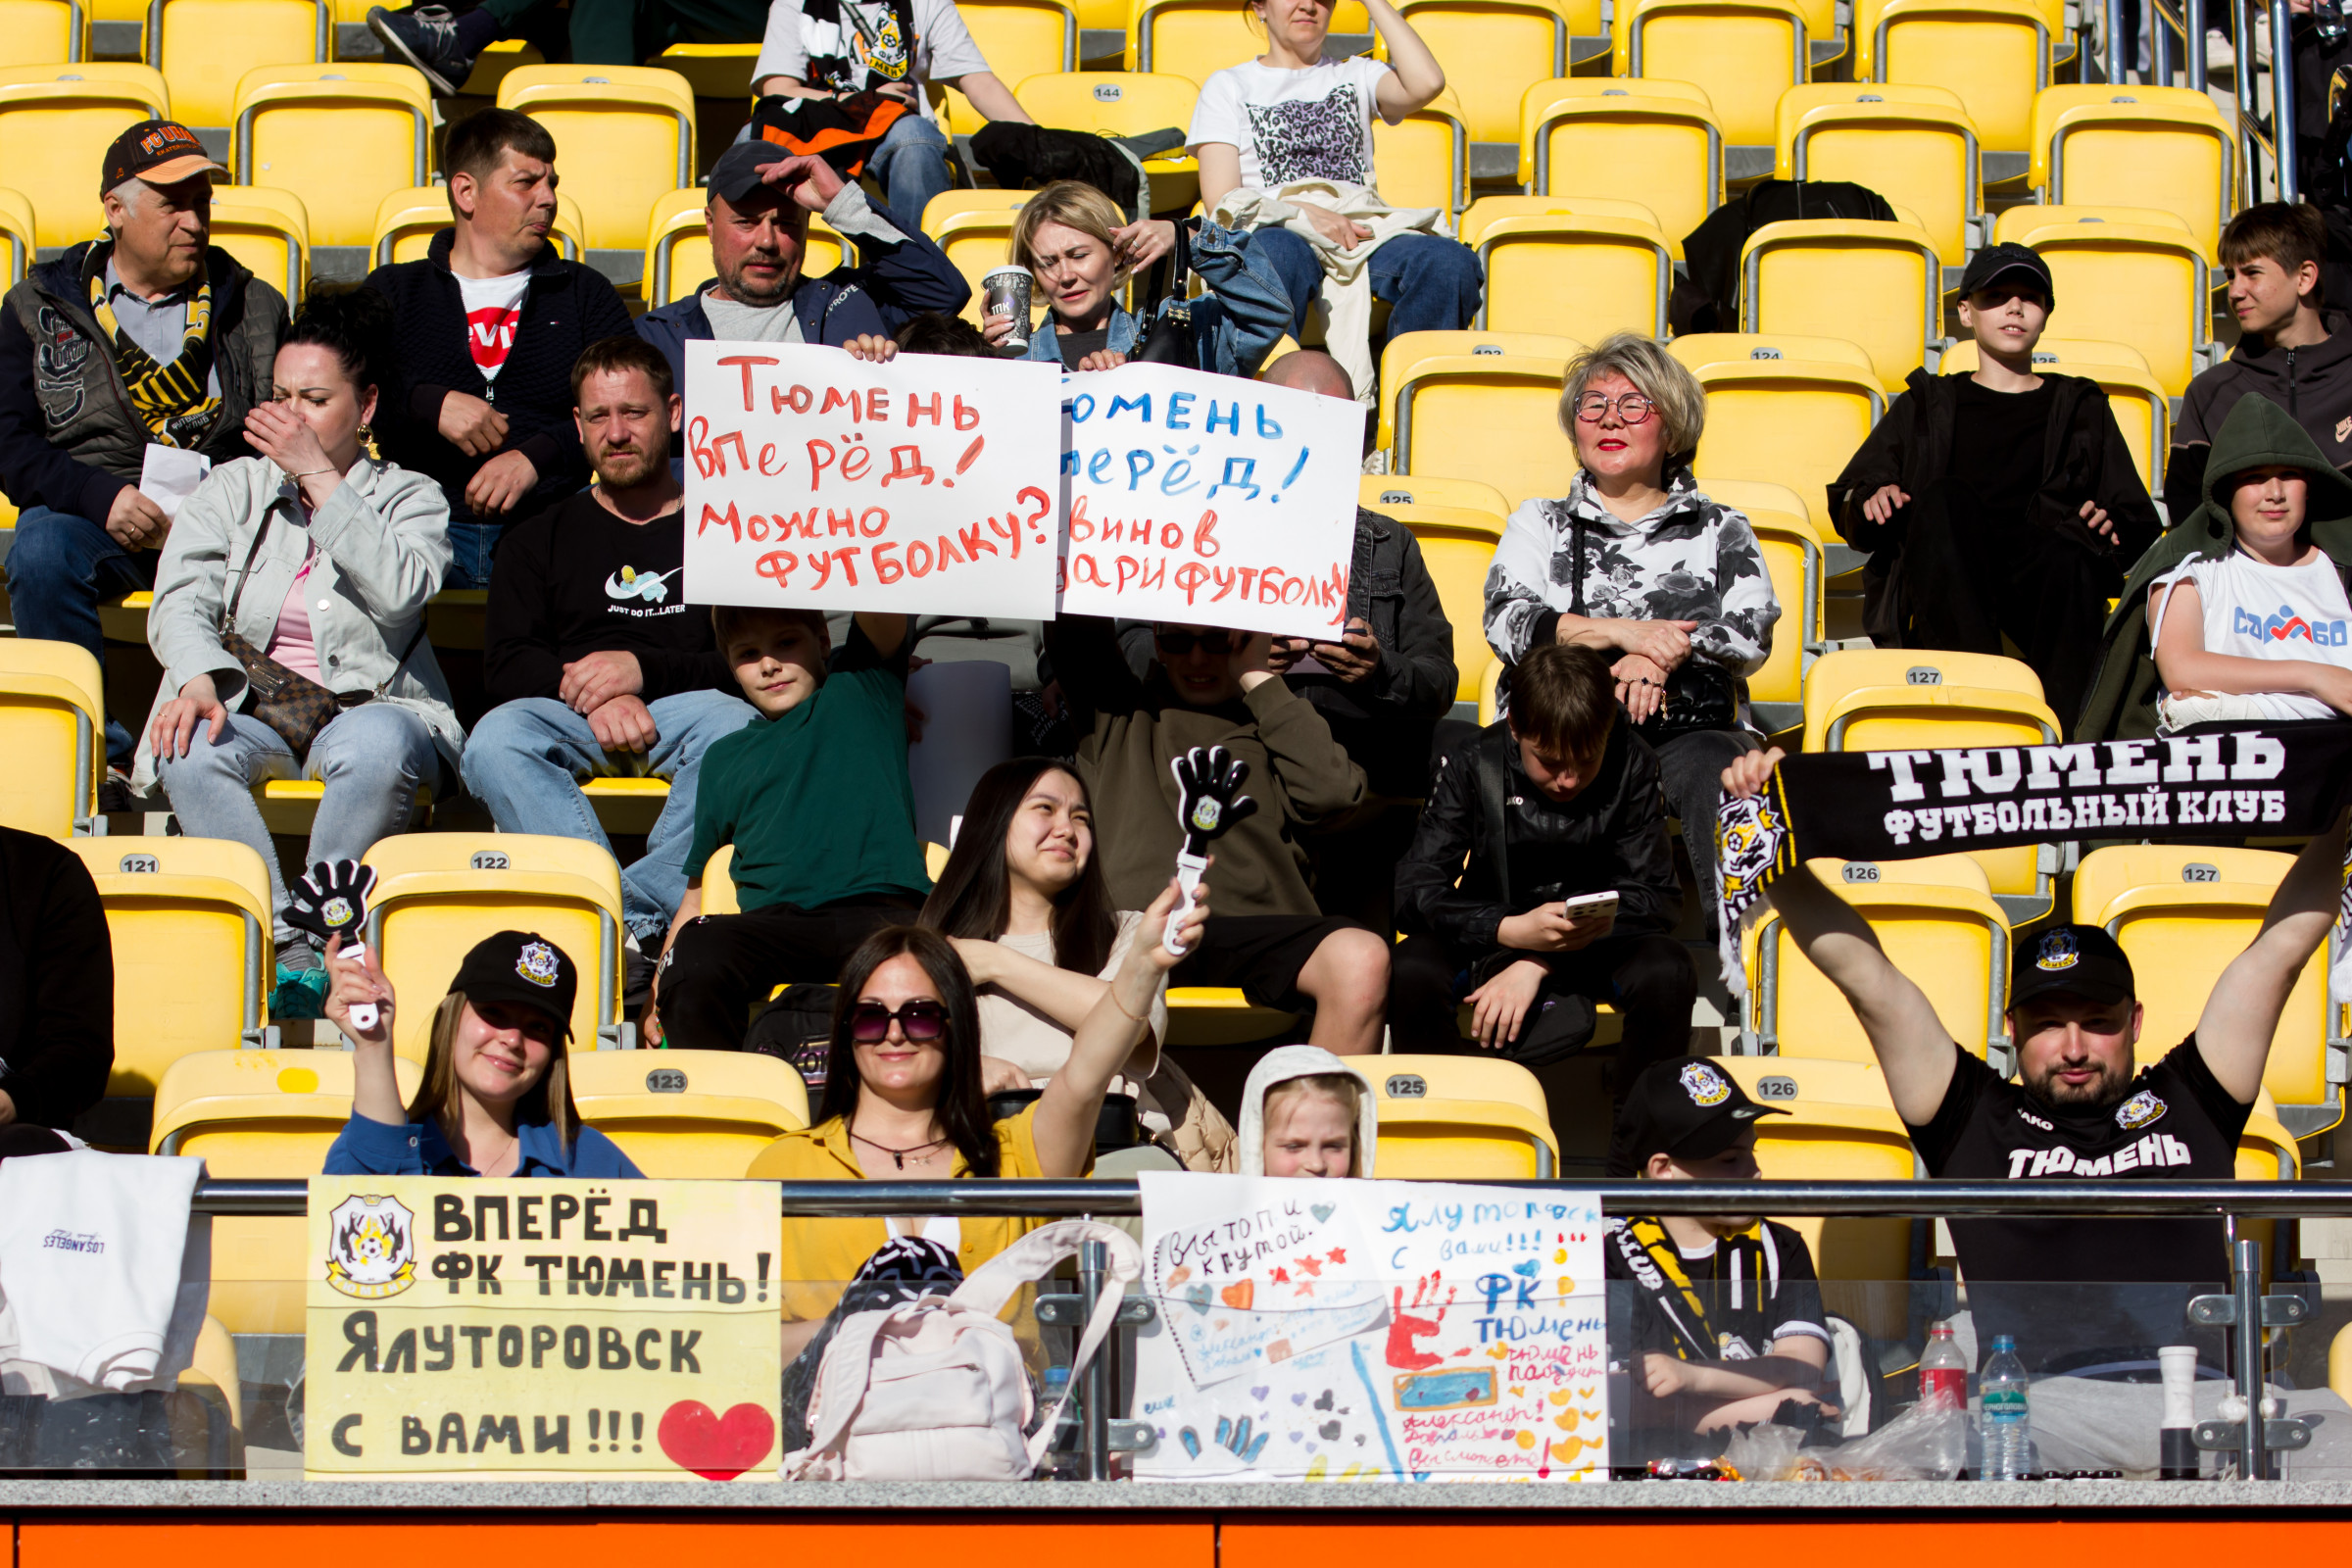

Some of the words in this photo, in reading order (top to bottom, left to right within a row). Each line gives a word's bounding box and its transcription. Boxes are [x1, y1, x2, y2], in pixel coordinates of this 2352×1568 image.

[1094, 86, 1119, 98] 144
[140, 131, 165, 155] FC
[1060, 444, 1310, 504] перёд!
[607, 604, 630, 614] JUST
[630, 609, 644, 617] DO
[1909, 671, 1939, 683] 127
[1867, 730, 2286, 803] ТЮМЕНЬ
[1884, 784, 2170, 846] ФУТБОЛЬНЫЙ
[2177, 789, 2286, 824] КЛУБ
[123, 859, 157, 873] 121
[473, 857, 508, 869] 122
[1844, 867, 1878, 879] 126
[2183, 868, 2216, 881] 127
[649, 1074, 686, 1090] 123
[1388, 1079, 1425, 1095] 125
[1759, 1082, 1794, 1096] 126
[2008, 1132, 2191, 1179] ТЮМЕНЬ
[433, 1188, 667, 1244] ВПЕРЁД
[431, 1251, 504, 1296] ФК
[525, 1252, 772, 1304] ТЮМЕНЬ!
[1475, 1273, 1542, 1314] ФК
[335, 1310, 703, 1374] ЯЛУТОРОВСК
[331, 1413, 363, 1458] С
